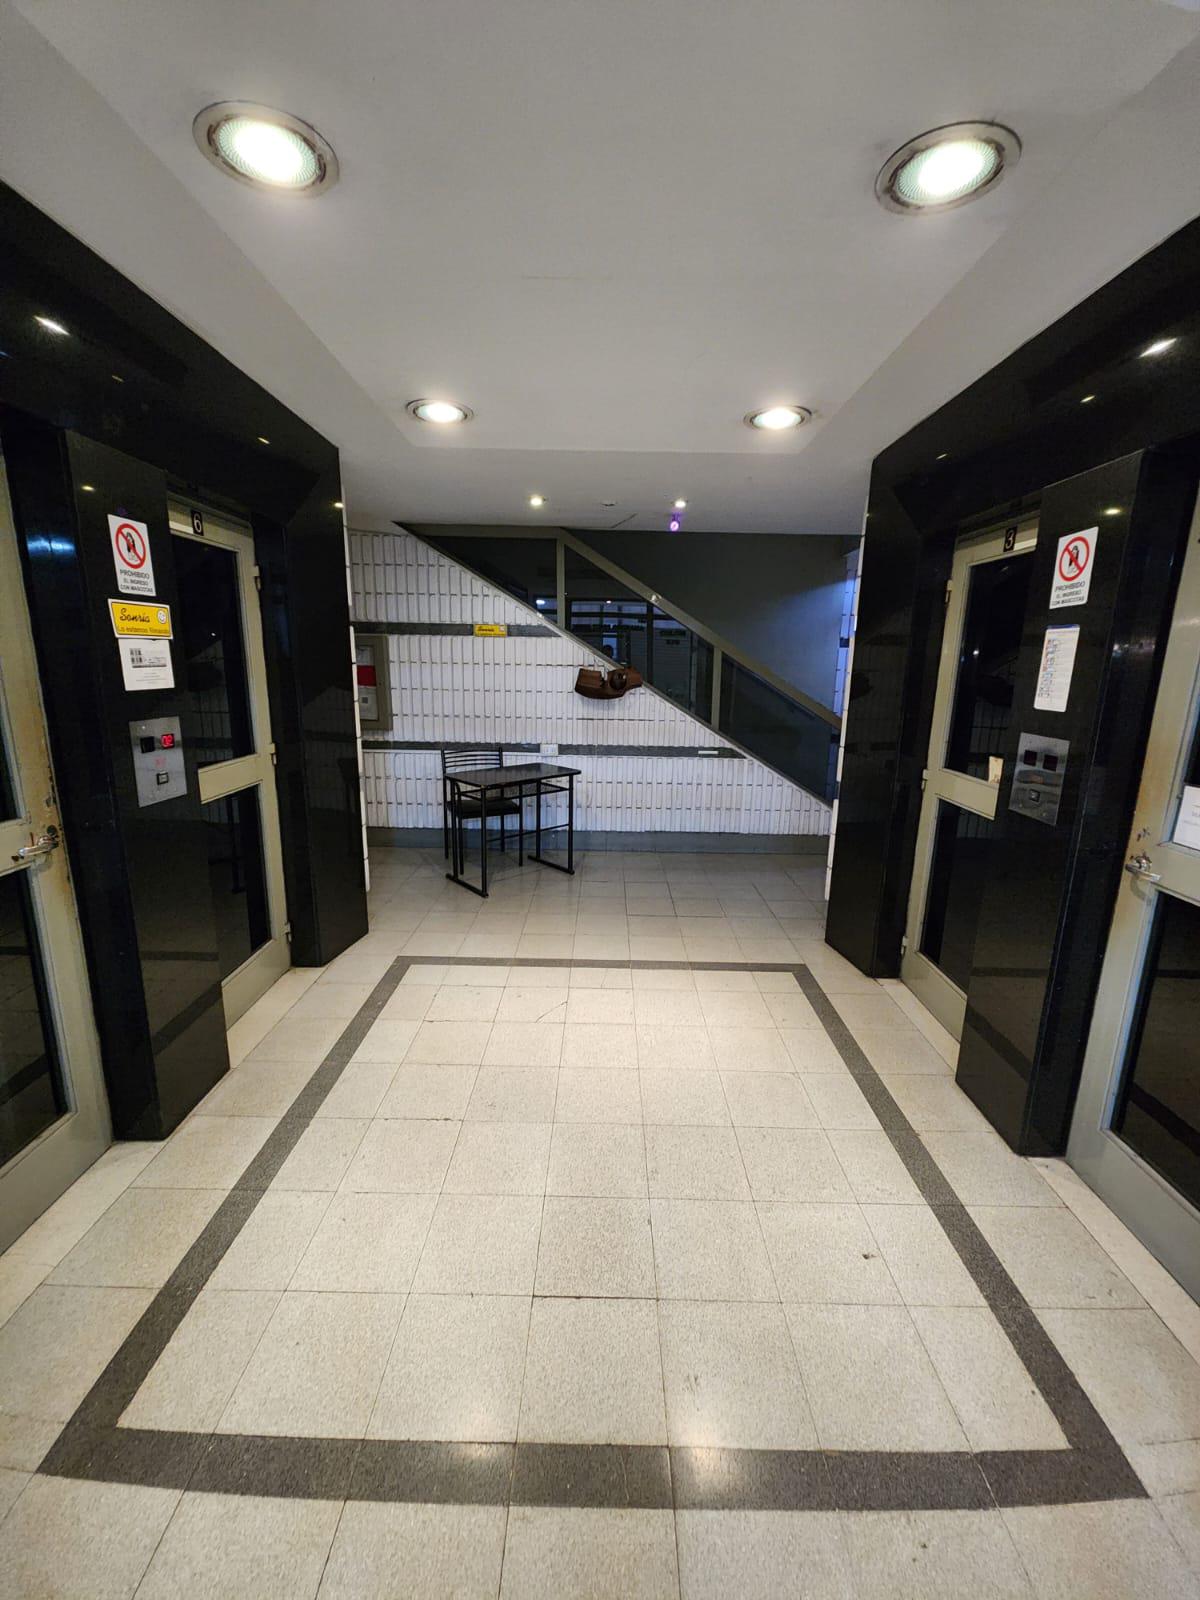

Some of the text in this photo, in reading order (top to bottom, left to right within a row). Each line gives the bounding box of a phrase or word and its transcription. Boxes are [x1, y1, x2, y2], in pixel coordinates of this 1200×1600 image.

[193, 513, 202, 533] 6
[1005, 529, 1014, 550] 3
[119, 569, 150, 580] PROHIBIDO
[1054, 580, 1086, 592] PROHIBIDO
